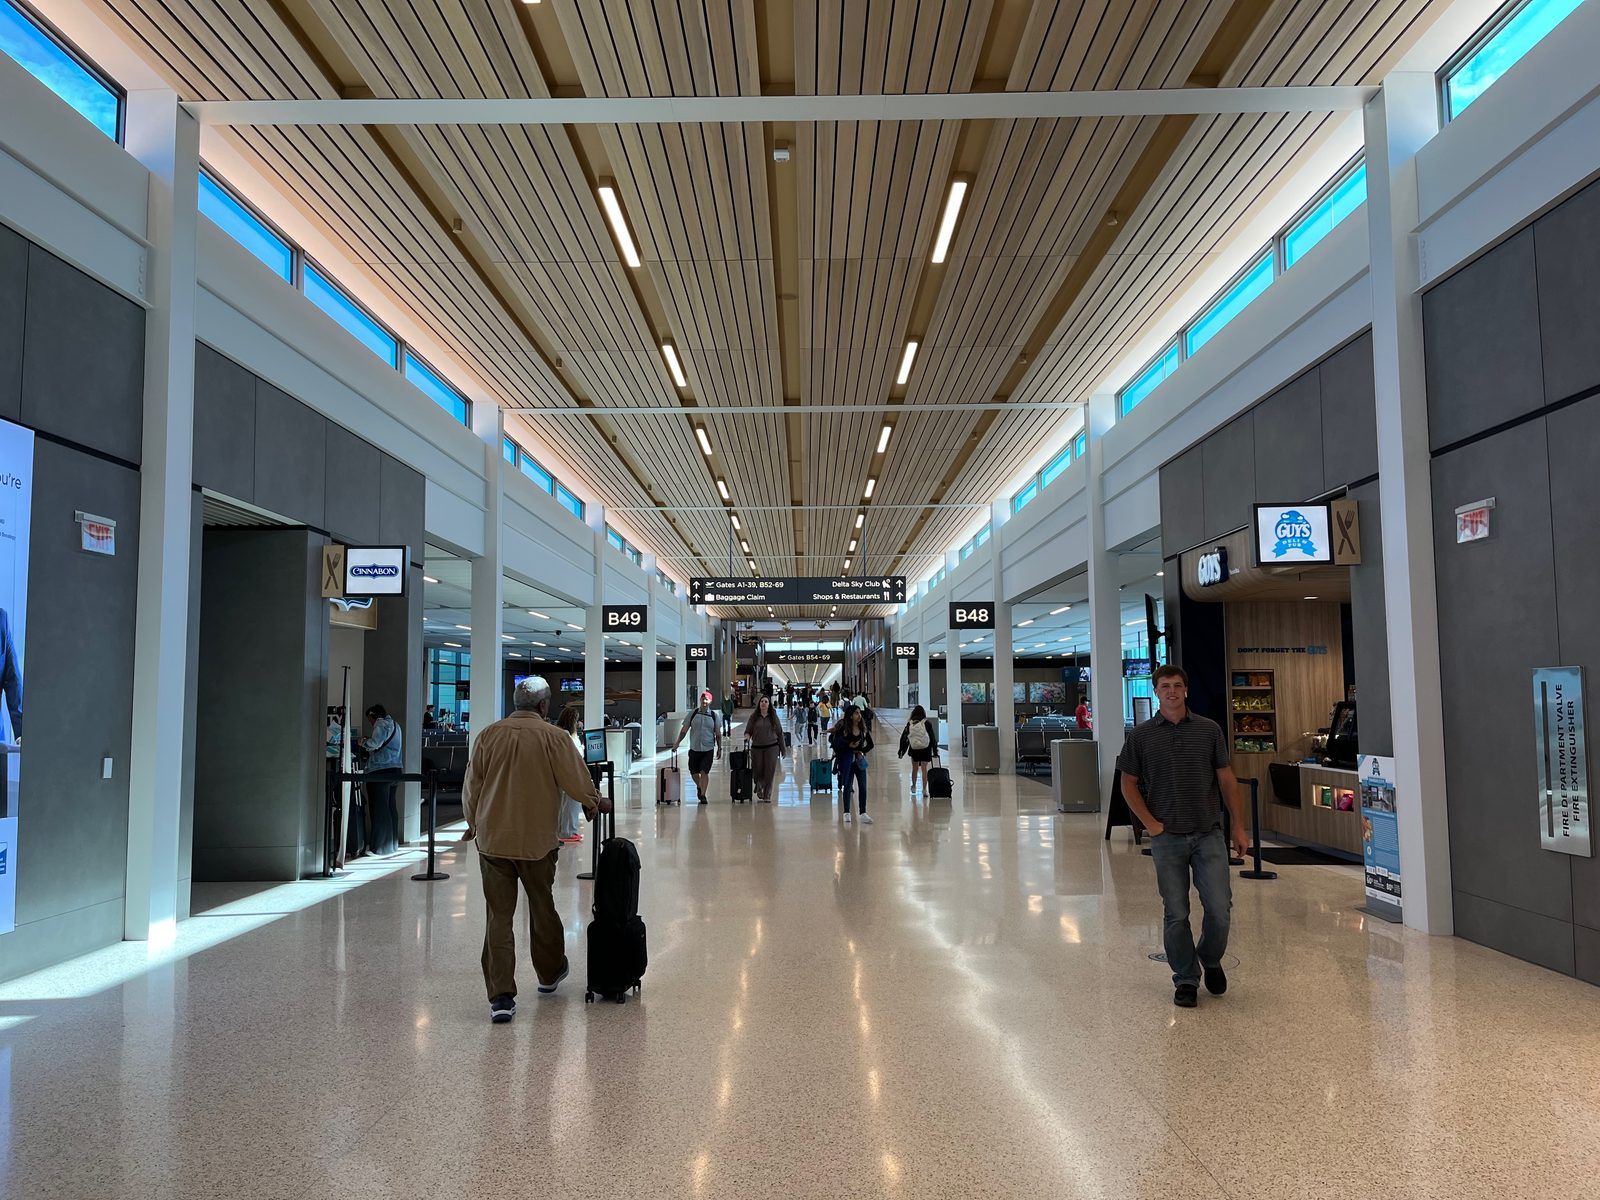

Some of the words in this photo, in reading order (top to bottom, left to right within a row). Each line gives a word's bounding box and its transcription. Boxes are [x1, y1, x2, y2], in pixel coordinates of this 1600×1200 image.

[0, 473, 22, 490] u're
[352, 567, 396, 576] CINNABON
[737, 581, 758, 589] A1-39,
[851, 580, 864, 588] Sky
[746, 593, 766, 601] Claim
[812, 593, 834, 601] Shops
[608, 612, 641, 626] B49
[955, 608, 989, 623] B48
[690, 647, 707, 657] B51
[896, 646, 915, 655] B52
[1555, 683, 1564, 723] VALVE
[1568, 701, 1578, 791] EXTINGUISHER
[1559, 726, 1568, 809] DEPARTMENT
[1572, 796, 1580, 822] FIRE
[1562, 810, 1570, 838] FIRE
